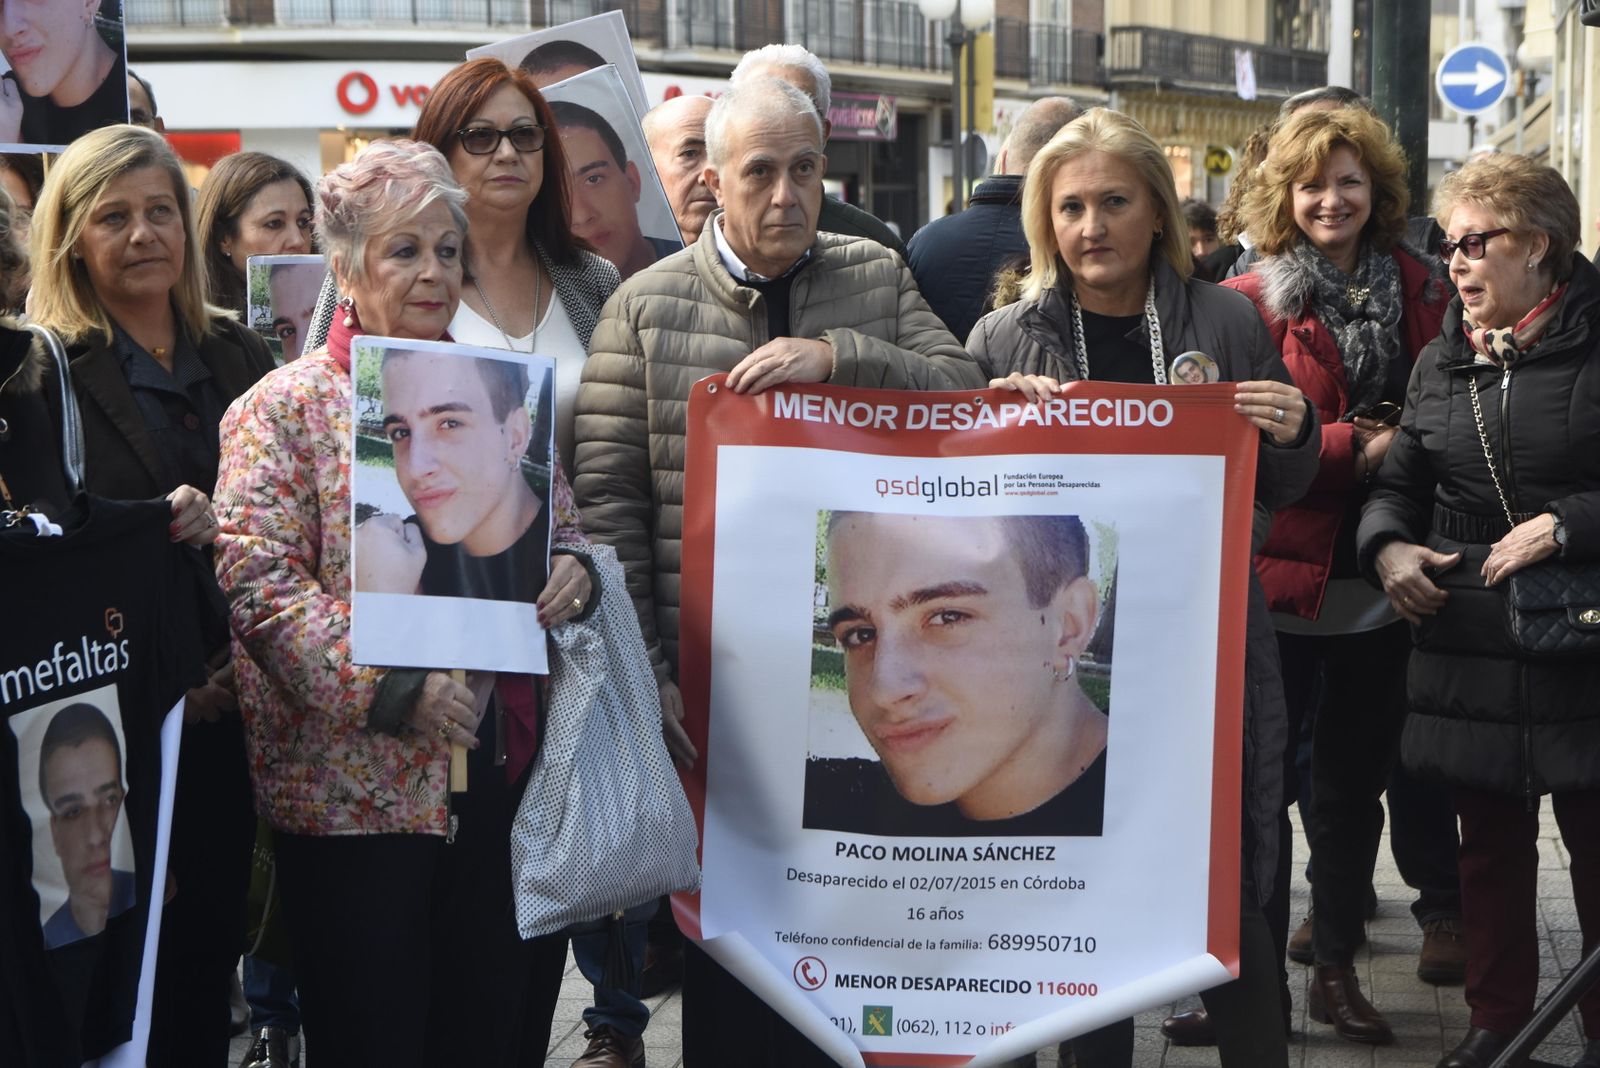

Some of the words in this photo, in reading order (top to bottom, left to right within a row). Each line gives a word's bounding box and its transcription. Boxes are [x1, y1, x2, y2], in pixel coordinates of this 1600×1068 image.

[774, 391, 899, 430] MENOR
[905, 398, 1174, 431] DESAPARECIDO
[1003, 472, 1037, 480] Fundación
[1039, 472, 1064, 481] Europea
[1057, 480, 1101, 489] Desaparecidas
[875, 474, 999, 503] qsdglobal
[0, 635, 130, 704] mefaltas
[835, 841, 887, 861] PACO
[892, 846, 968, 862] MOLINA
[972, 842, 1056, 861] SÁNCHEZ
[786, 867, 888, 889] Desaparecido
[892, 876, 905, 889] el
[909, 876, 996, 892] 02/07/2015
[1000, 878, 1018, 889] en
[1023, 875, 1086, 890] Córdoba
[907, 907, 925, 920] 16
[929, 906, 964, 920] años
[774, 931, 828, 945] Teléfono
[831, 935, 905, 949] confidencial
[907, 938, 922, 950] de
[925, 939, 936, 950] la
[939, 938, 983, 950] familia:
[988, 933, 1097, 953] 689950710
[834, 973, 897, 990] MENOR
[901, 976, 1032, 994] DESAPARECIDO
[1037, 981, 1098, 996] 116000
[896, 1018, 939, 1036] (062),
[944, 1021, 971, 1036] 112
[976, 1025, 986, 1036] o
[990, 1021, 1017, 1036] inf
